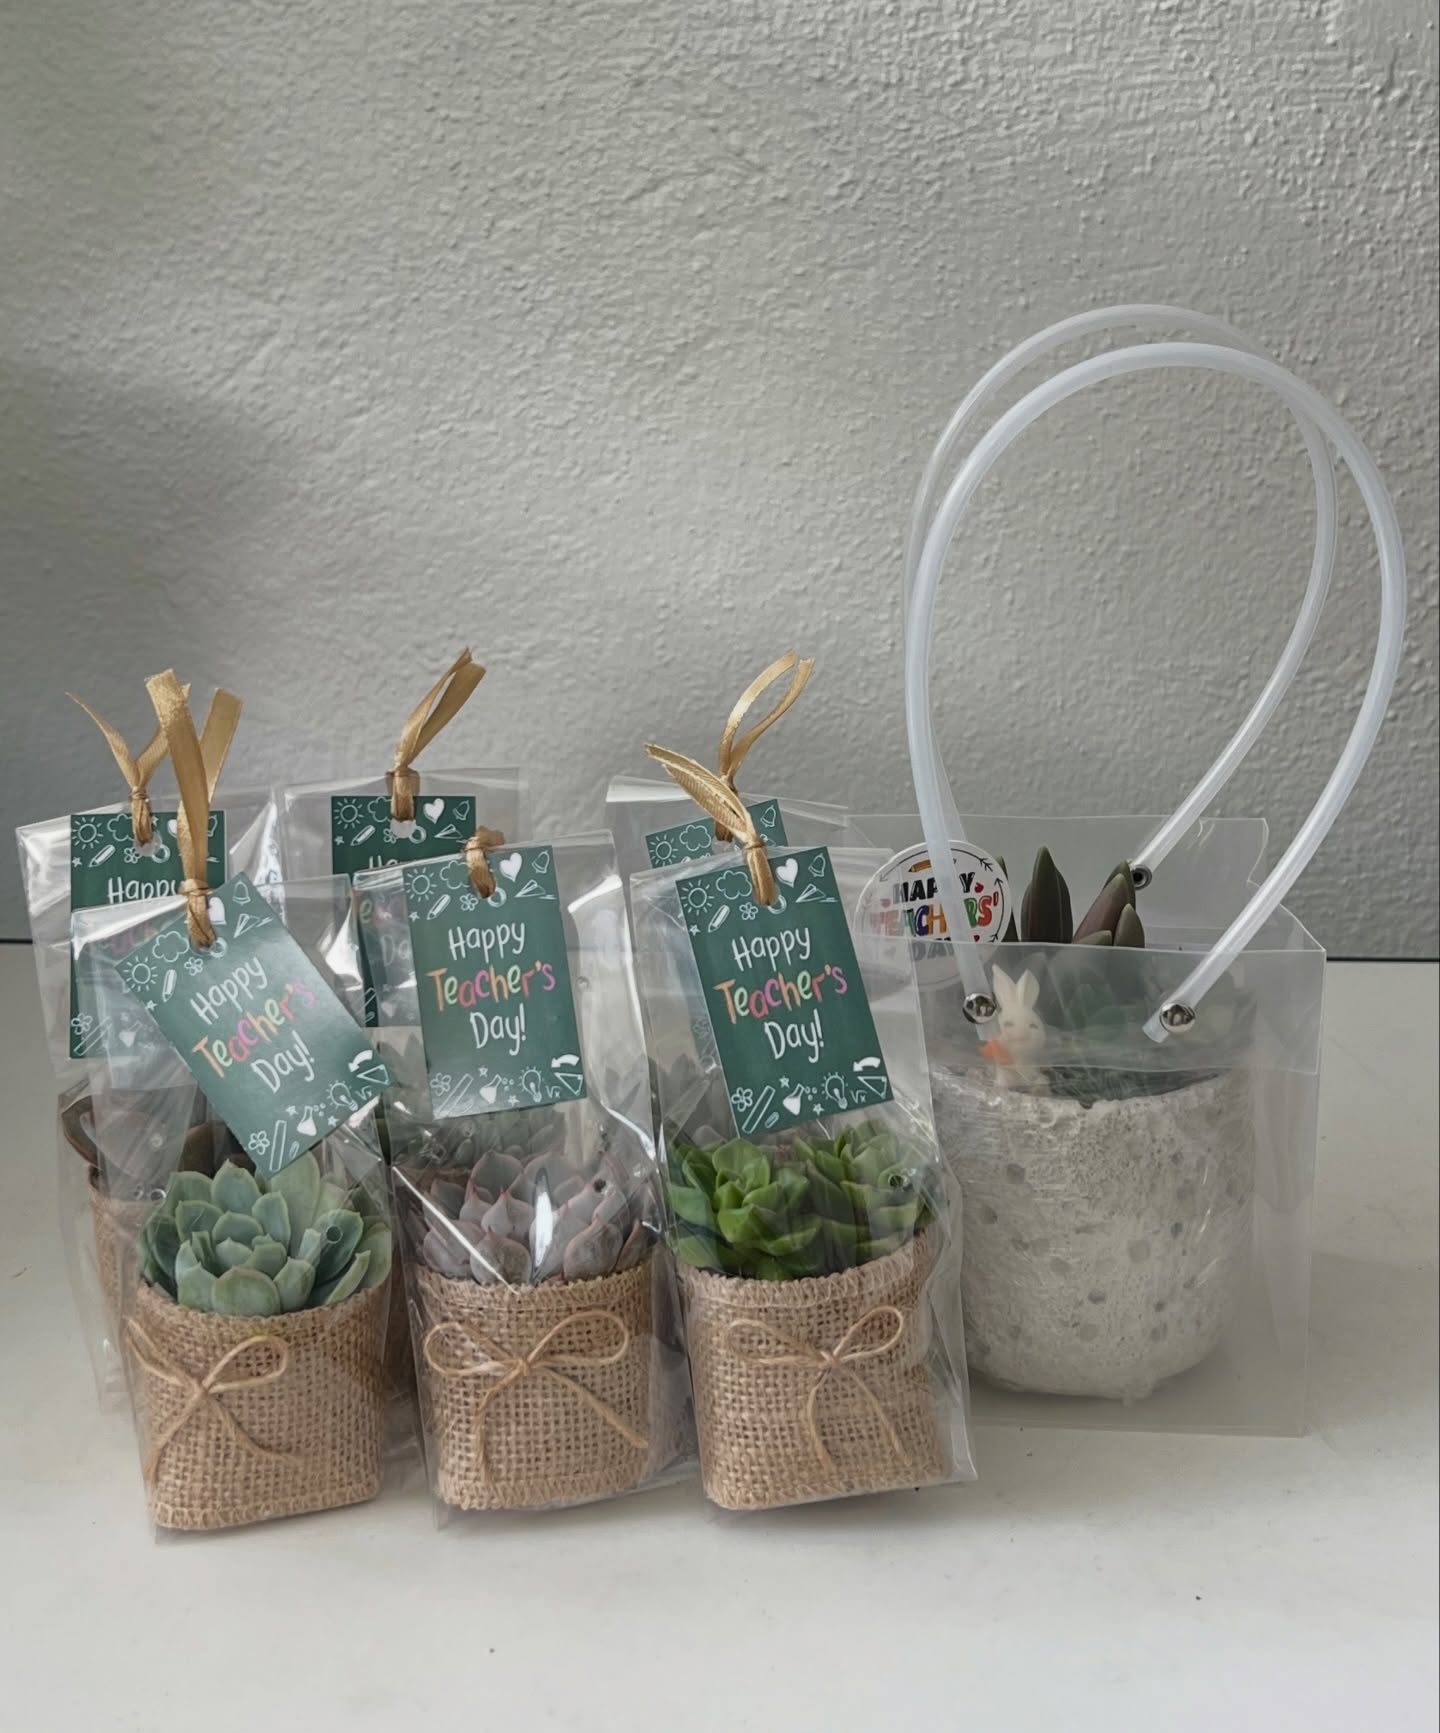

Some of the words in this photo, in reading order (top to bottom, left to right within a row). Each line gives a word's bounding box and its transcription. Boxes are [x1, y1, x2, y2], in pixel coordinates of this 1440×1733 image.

[107, 876, 177, 904] Happ
[869, 891, 1000, 937] TEACHRS'
[892, 871, 976, 904] HAPY
[447, 921, 526, 963] Happy
[731, 926, 811, 972] Happy
[190, 956, 268, 1025] Happy
[424, 960, 556, 1012] Teacher's
[712, 963, 849, 1025] Teacher's
[192, 980, 316, 1079] Teacher's
[469, 1002, 527, 1057] Day!
[764, 1008, 825, 1063] Day!
[250, 1029, 315, 1094] Day!
